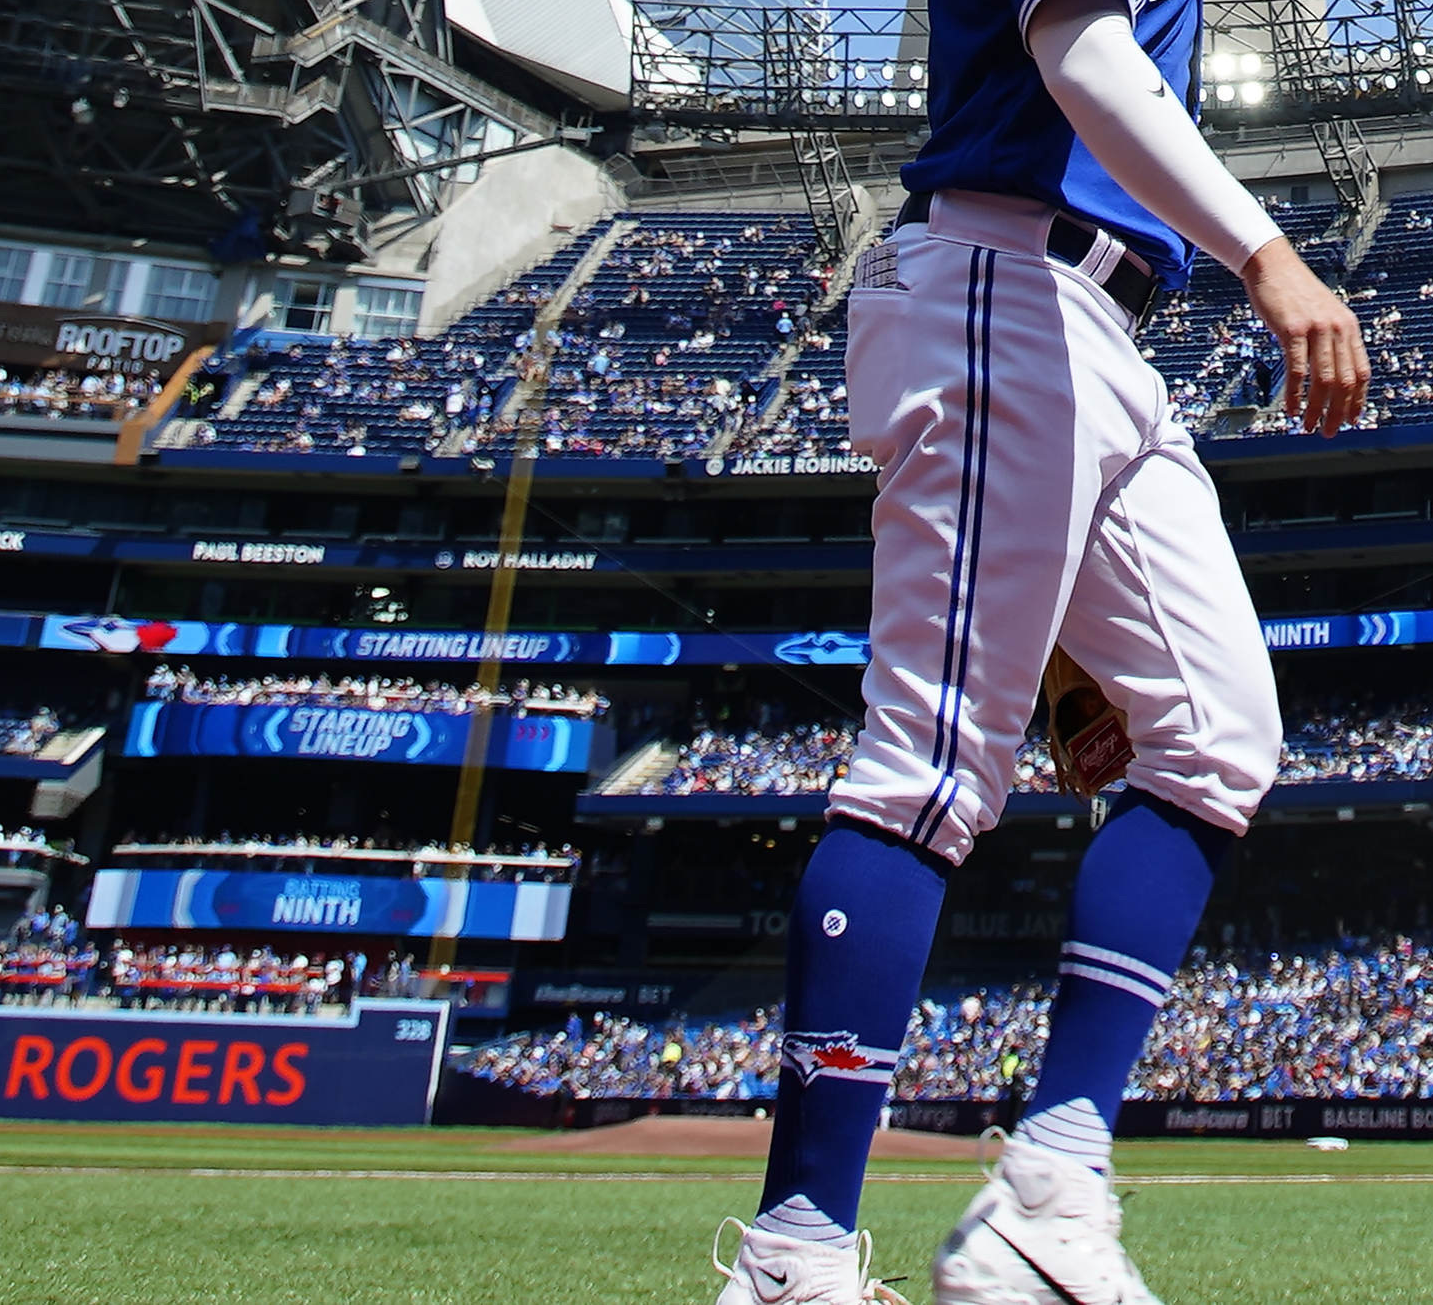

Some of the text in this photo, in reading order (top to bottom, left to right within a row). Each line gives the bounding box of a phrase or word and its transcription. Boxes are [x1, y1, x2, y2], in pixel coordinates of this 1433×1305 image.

[56, 323, 185, 363] ROOFTOP
[86, 354, 145, 373] PATIO
[730, 457, 792, 475] JACKIE
[793, 456, 885, 474] ROBINSO
[192, 541, 325, 564] PAUL BEESTON
[462, 550, 502, 569] ROY
[503, 551, 598, 570] HALLADAY
[355, 632, 551, 661] STARTING LINEUP
[1265, 622, 1330, 647] NINTH
[289, 707, 413, 738] STARTING
[298, 732, 394, 757] LINEUP
[284, 878, 362, 897] BATTING
[272, 894, 363, 926] NINTH
[3, 1034, 310, 1108] ROGERS
[1260, 1105, 1296, 1130] BET
[1322, 1107, 1408, 1129] BASELINE
